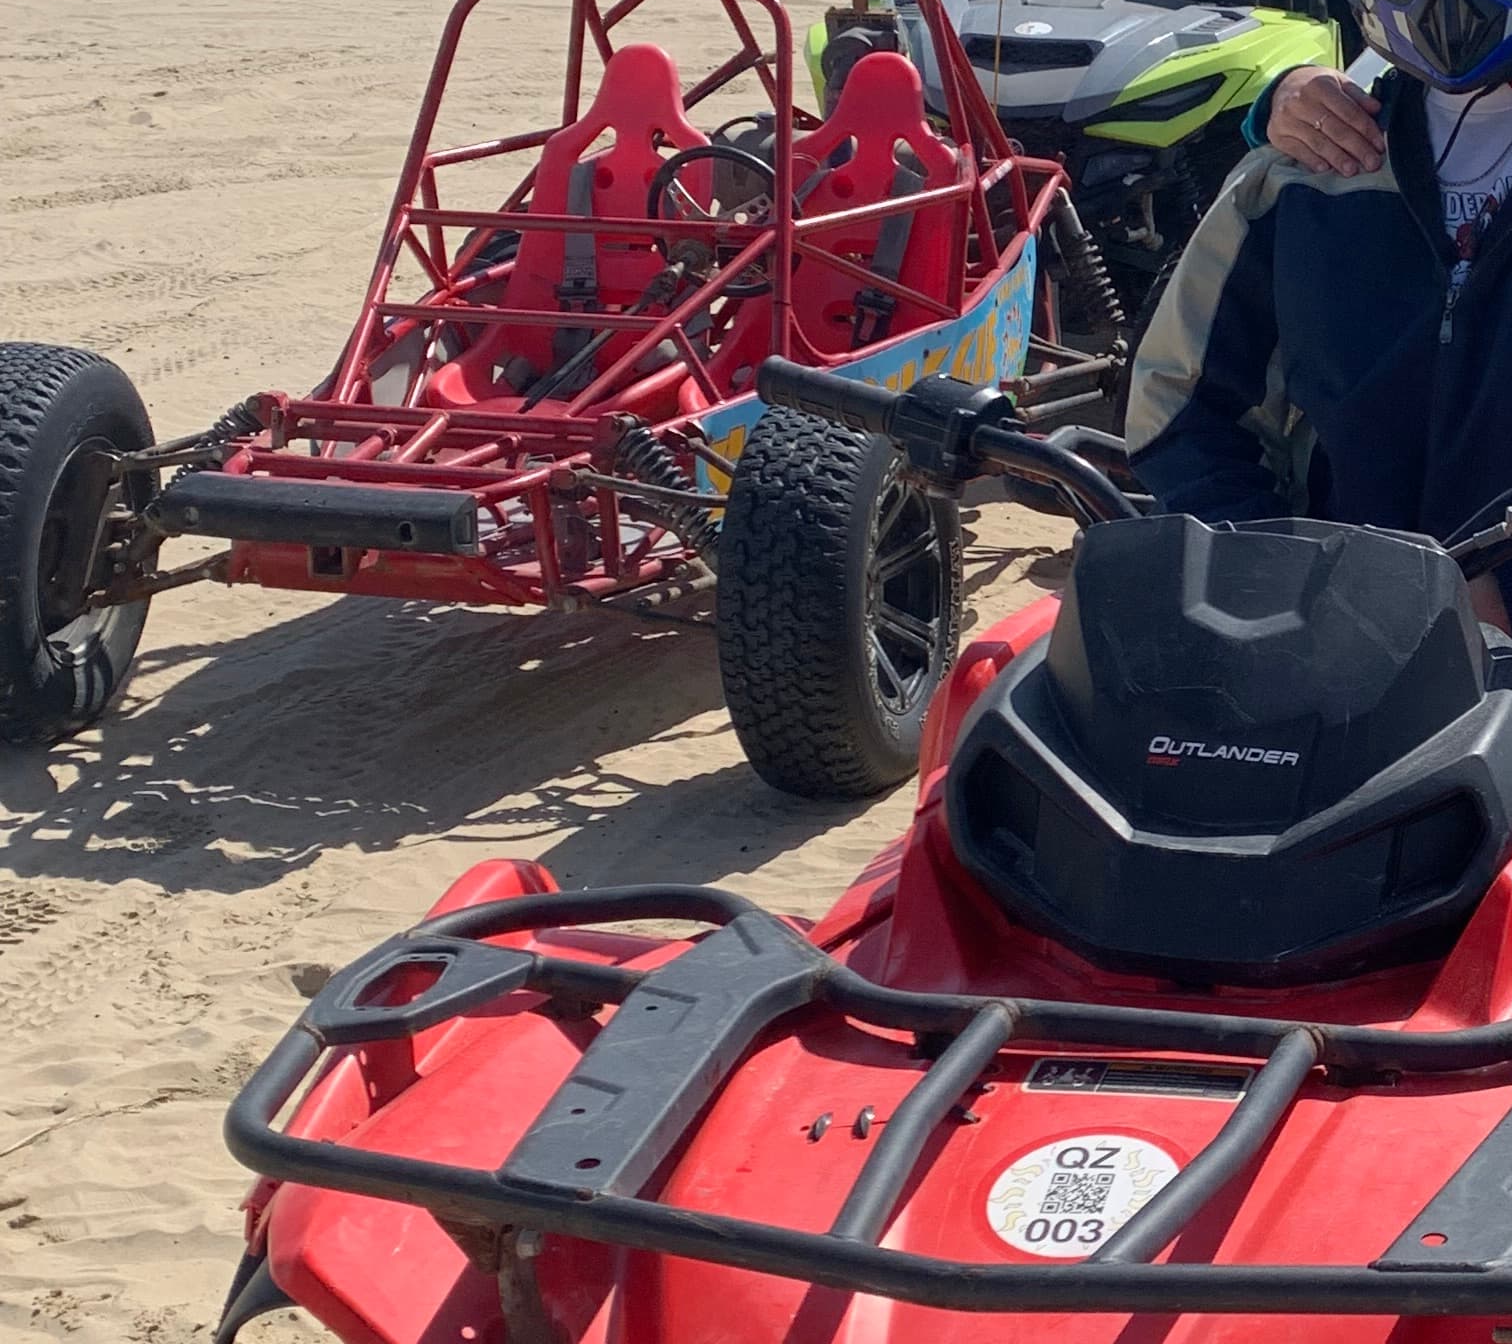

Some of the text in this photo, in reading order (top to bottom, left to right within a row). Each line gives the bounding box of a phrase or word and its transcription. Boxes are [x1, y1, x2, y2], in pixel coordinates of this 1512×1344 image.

[1149, 736, 1299, 766] OUTLANDER
[1056, 1146, 1121, 1169] QZ
[1024, 1218, 1105, 1244] 003
